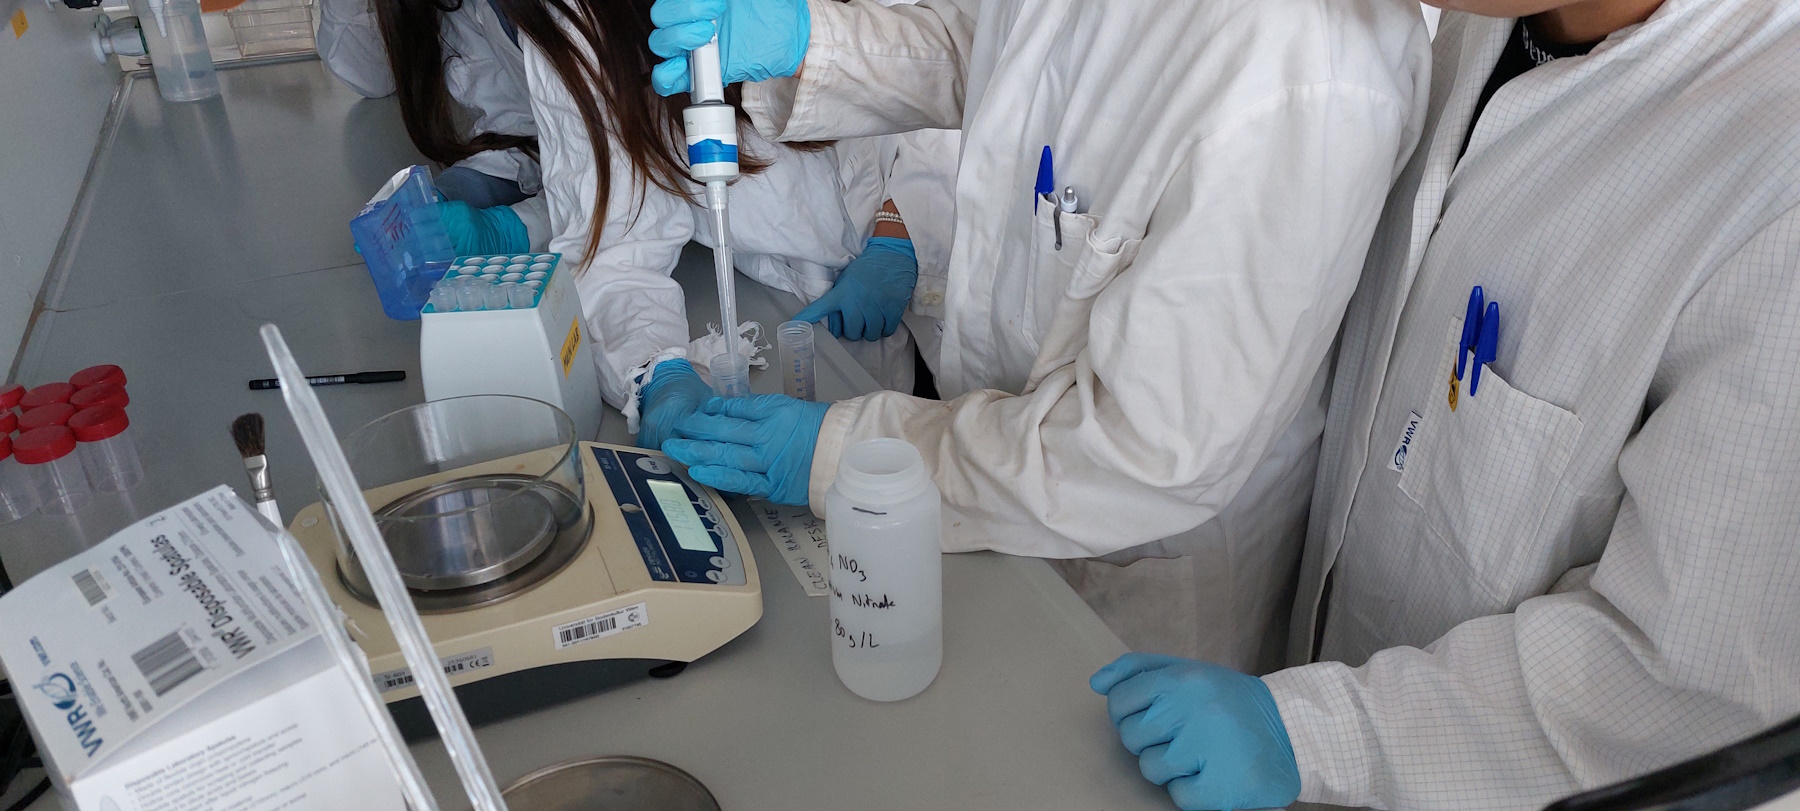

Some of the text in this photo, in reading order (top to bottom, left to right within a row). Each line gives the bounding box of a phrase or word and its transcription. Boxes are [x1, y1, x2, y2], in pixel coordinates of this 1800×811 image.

[1402, 420, 1418, 445] VWR
[151, 534, 191, 575] Spatulas
[765, 508, 827, 590] CLEAN BALANCE
[803, 520, 828, 548] DESK
[178, 571, 233, 629] Disposable
[851, 594, 896, 610] Nitrate
[67, 704, 104, 757] VWR
